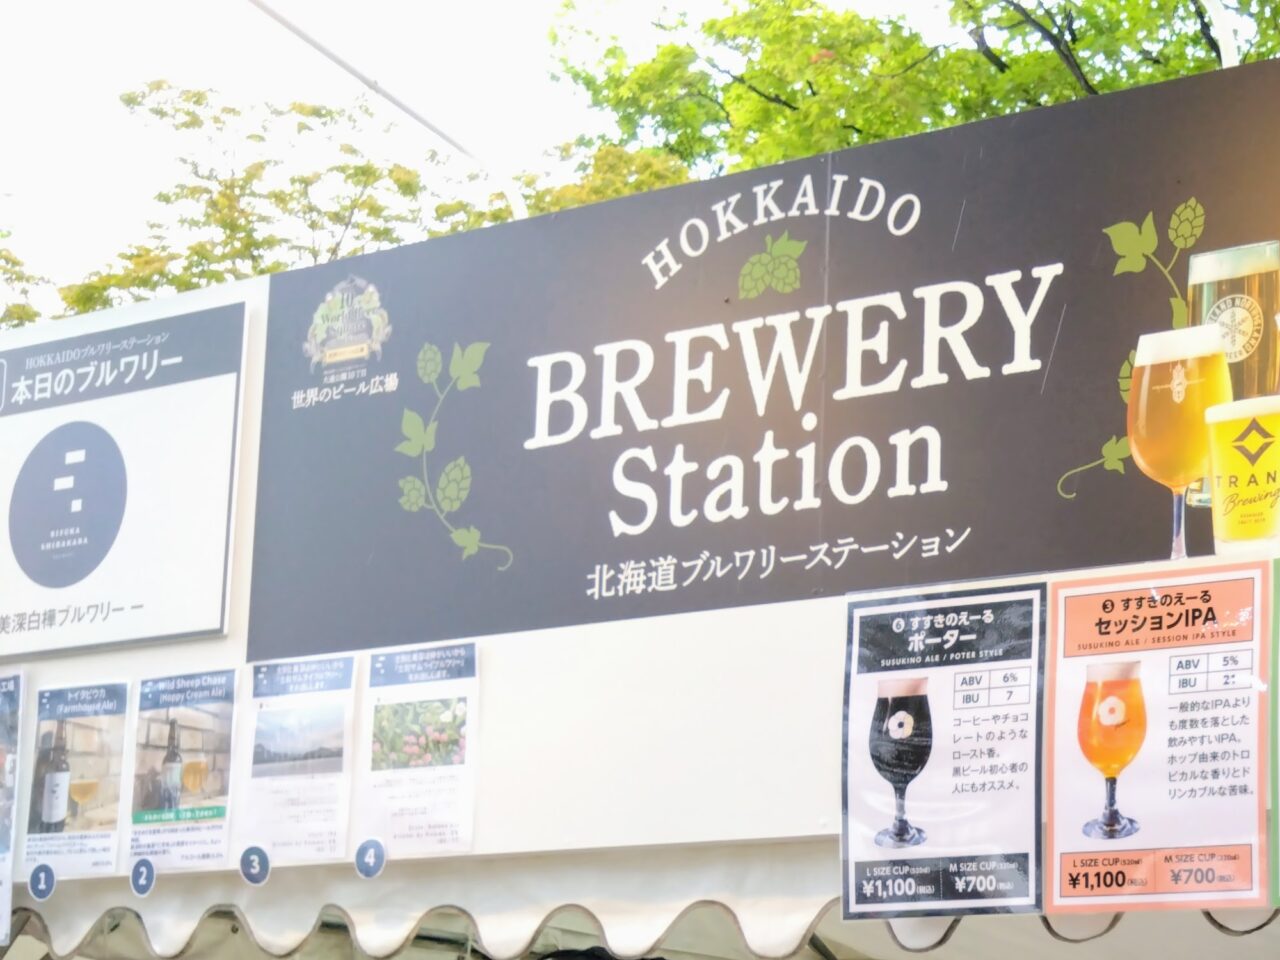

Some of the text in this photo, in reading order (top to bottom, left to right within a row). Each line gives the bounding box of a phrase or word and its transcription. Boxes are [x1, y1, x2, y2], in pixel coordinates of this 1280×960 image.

[641, 174, 921, 290] HOKKAIDO
[523, 263, 1064, 449] BREWERY
[11, 350, 183, 405] 本日のブルワリー
[291, 372, 398, 409] 世界のビール広場
[608, 413, 948, 538] Station
[586, 527, 971, 600] 北海道ブルワリーステーション
[1121, 591, 1211, 611] すすきのえーる
[910, 608, 994, 630] すすきのえーる
[1095, 607, 1217, 635] セッションIPA
[908, 629, 977, 652] ポーター
[1078, 629, 1236, 650] SUSUKINO ALE SESSION STYLE
[881, 654, 940, 667] SUSUKINO ALE
[1176, 656, 1238, 670] ABV 5%
[202, 676, 226, 685] Chase
[960, 672, 1018, 686] ABV 6%
[1178, 678, 1196, 689] IBU
[962, 693, 979, 704] IBU
[1168, 696, 1251, 712] 一般的なIPAより
[953, 712, 1029, 728] コーヒーやチョコ
[1169, 715, 1250, 730] も度数を落とした
[953, 729, 1028, 743] レートのような
[1168, 733, 1241, 747] 飲みやすいIPA。
[1168, 750, 1250, 765] ホップ由来のトロ
[952, 761, 1028, 777] 黒ビール初心者の
[250, 855, 259, 874] 3
[364, 849, 375, 866] 4
[38, 872, 46, 890] 1
[139, 867, 147, 885] 2
